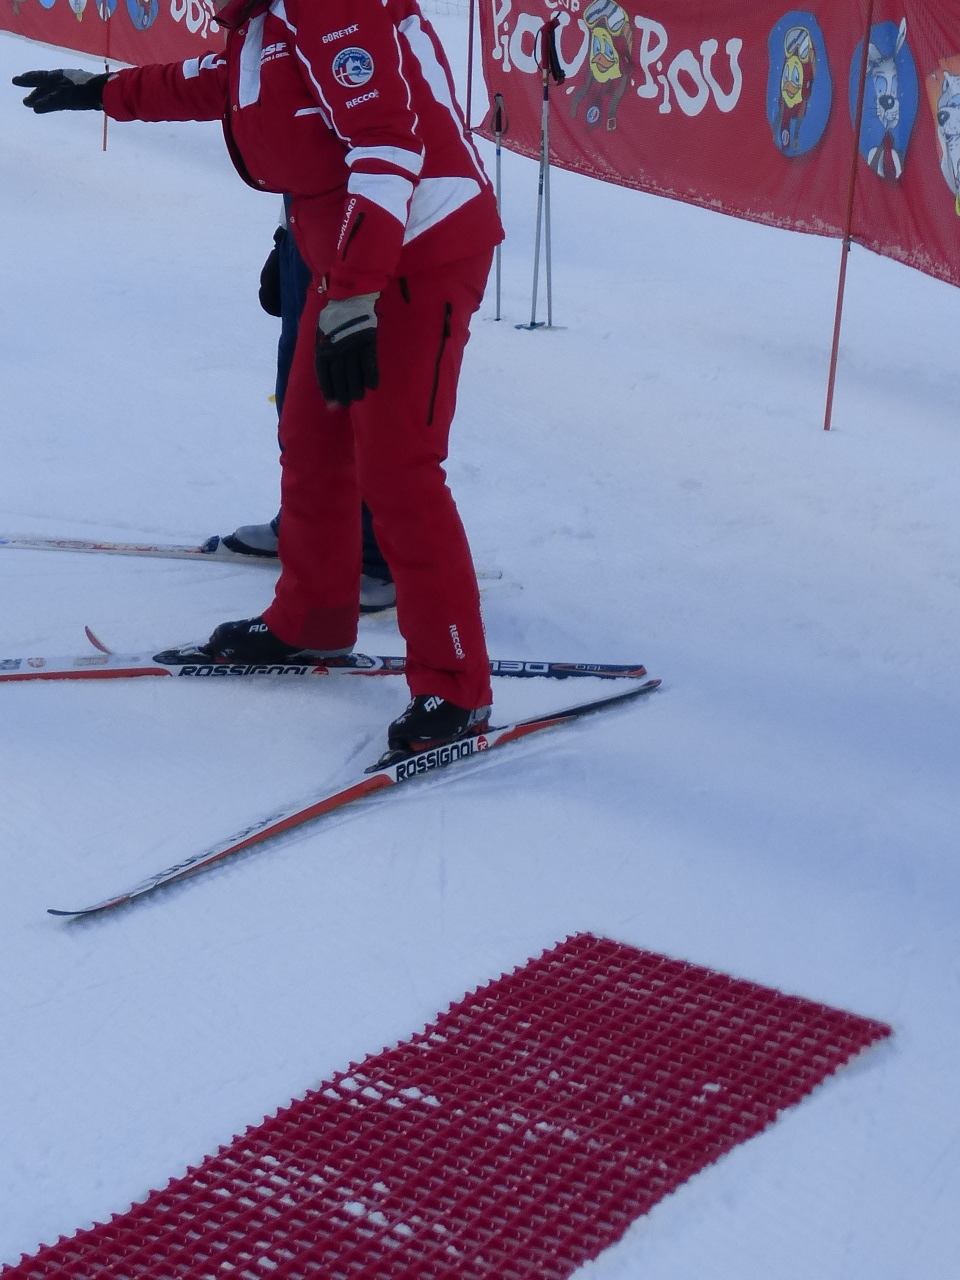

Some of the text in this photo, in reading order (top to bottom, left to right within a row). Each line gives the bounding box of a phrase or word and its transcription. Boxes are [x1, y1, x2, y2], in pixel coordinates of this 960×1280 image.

[345, 91, 376, 109] RECCO
[449, 623, 463, 656] RECCO
[396, 739, 474, 782] ROSSIGNOL
